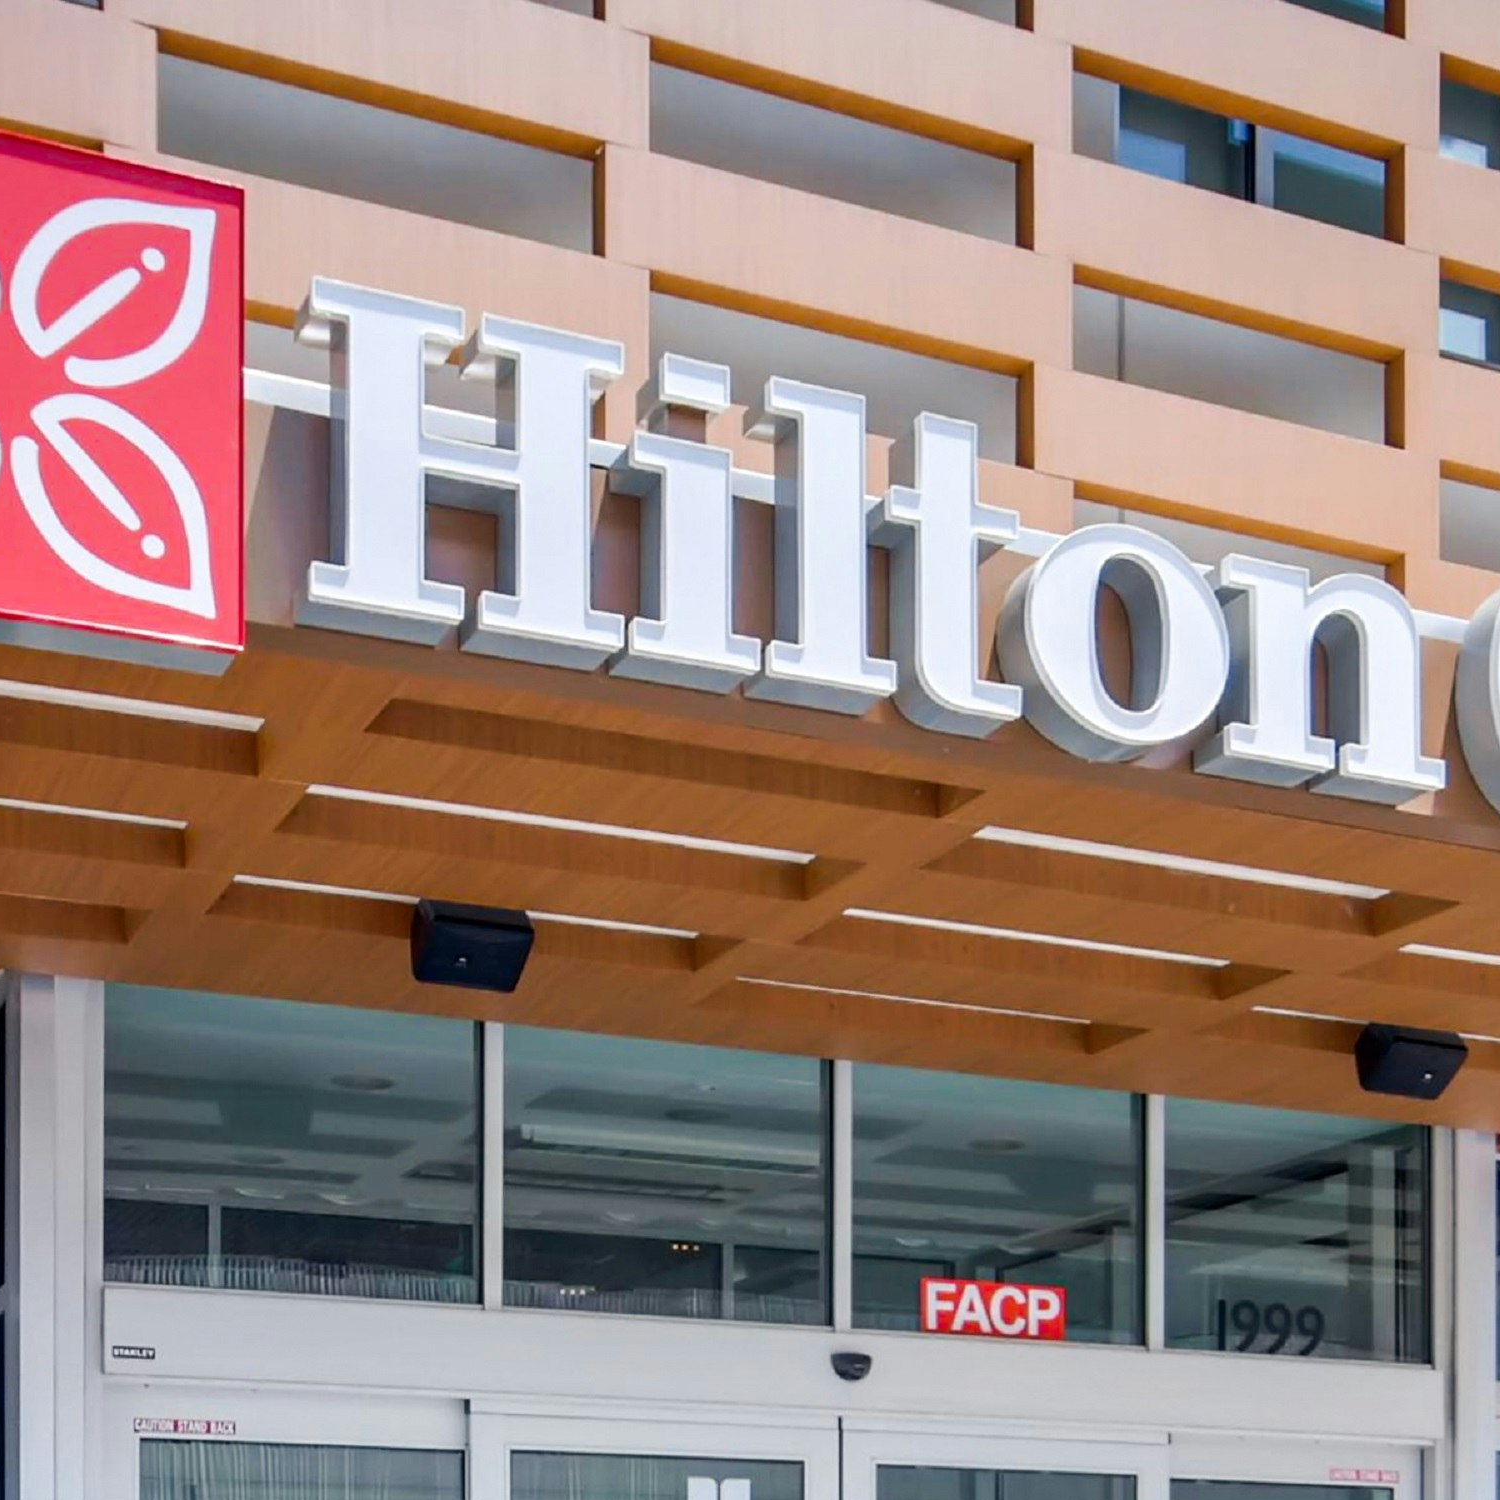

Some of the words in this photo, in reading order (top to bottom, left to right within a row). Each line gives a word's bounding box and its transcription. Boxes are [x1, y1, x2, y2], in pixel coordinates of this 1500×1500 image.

[300, 274, 1446, 802] Hilton
[926, 1281, 1061, 1338] FACP
[1218, 1298, 1326, 1357] 1999
[113, 1348, 155, 1359] STANLEY
[135, 1419, 174, 1432] CAUTION
[177, 1421, 207, 1434] STAND
[210, 1421, 235, 1434] BACK
